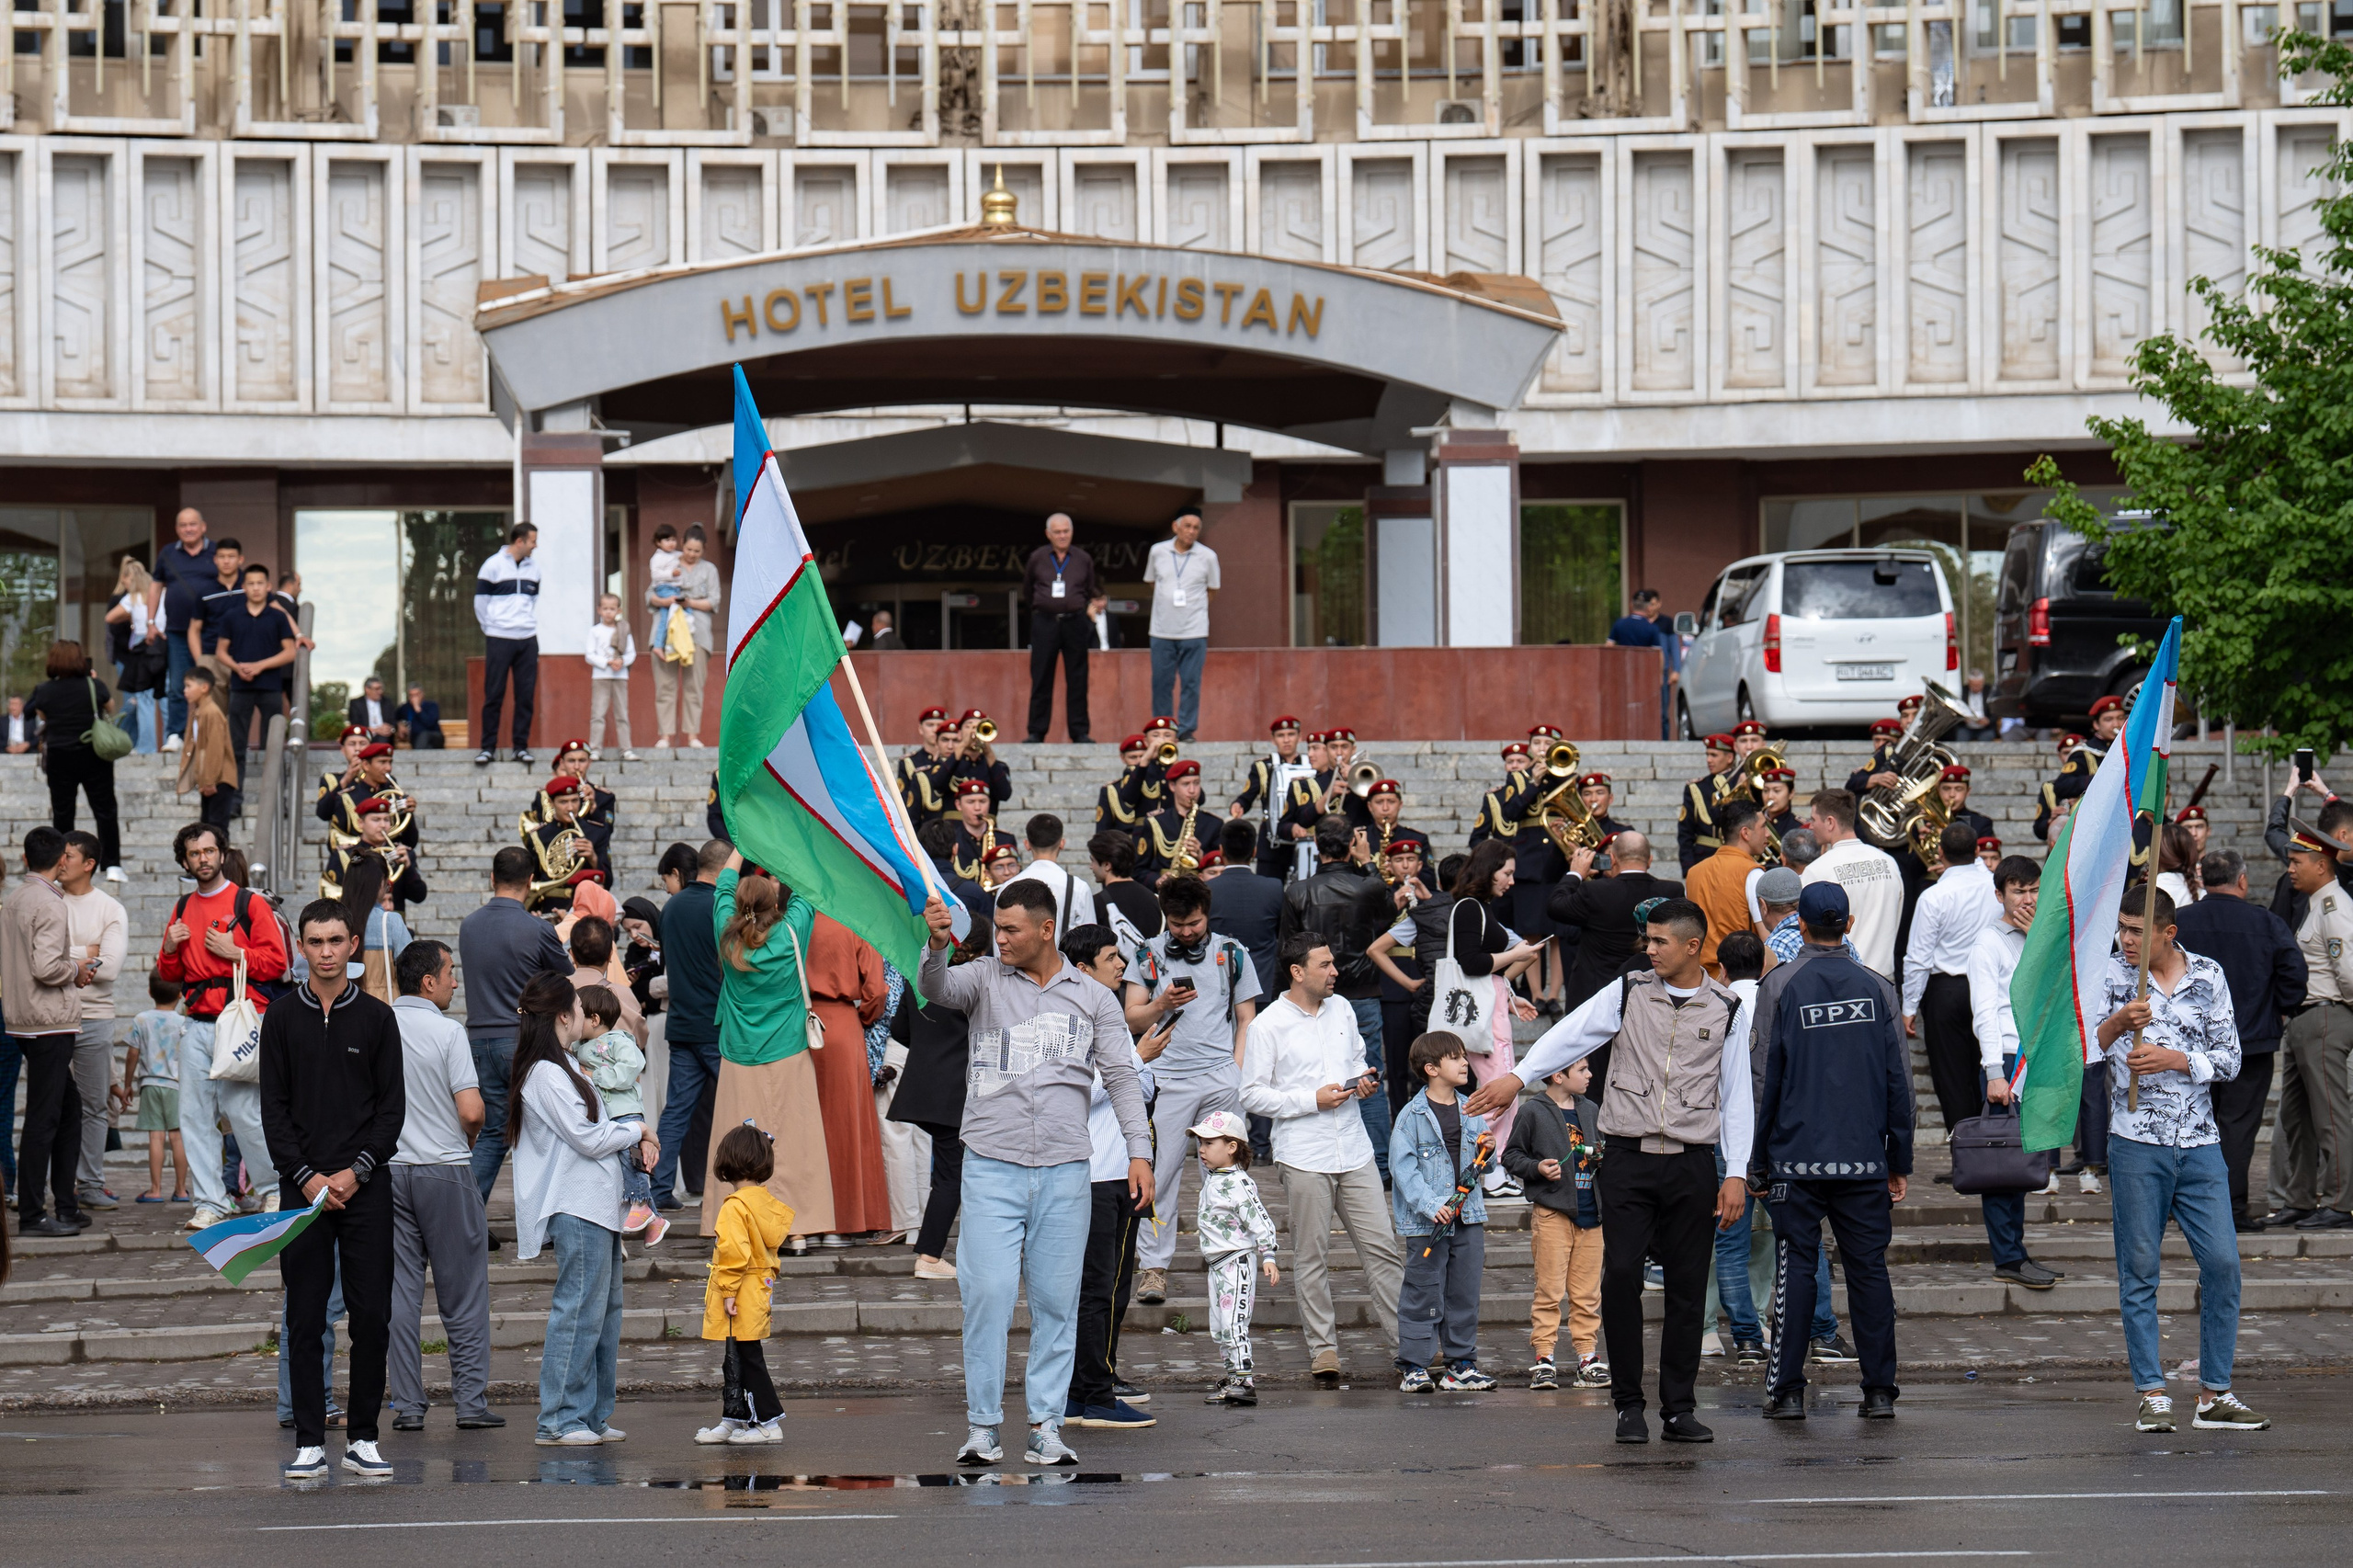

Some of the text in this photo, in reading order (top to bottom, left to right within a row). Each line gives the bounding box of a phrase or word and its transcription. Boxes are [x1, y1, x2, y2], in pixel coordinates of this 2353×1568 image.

[721, 270, 1324, 341] HOTEL UZBEKISTAN
[1834, 858, 1891, 881] REVERSE
[1868, 874, 1893, 882] EDITION
[1809, 1002, 1868, 1024] PPX
